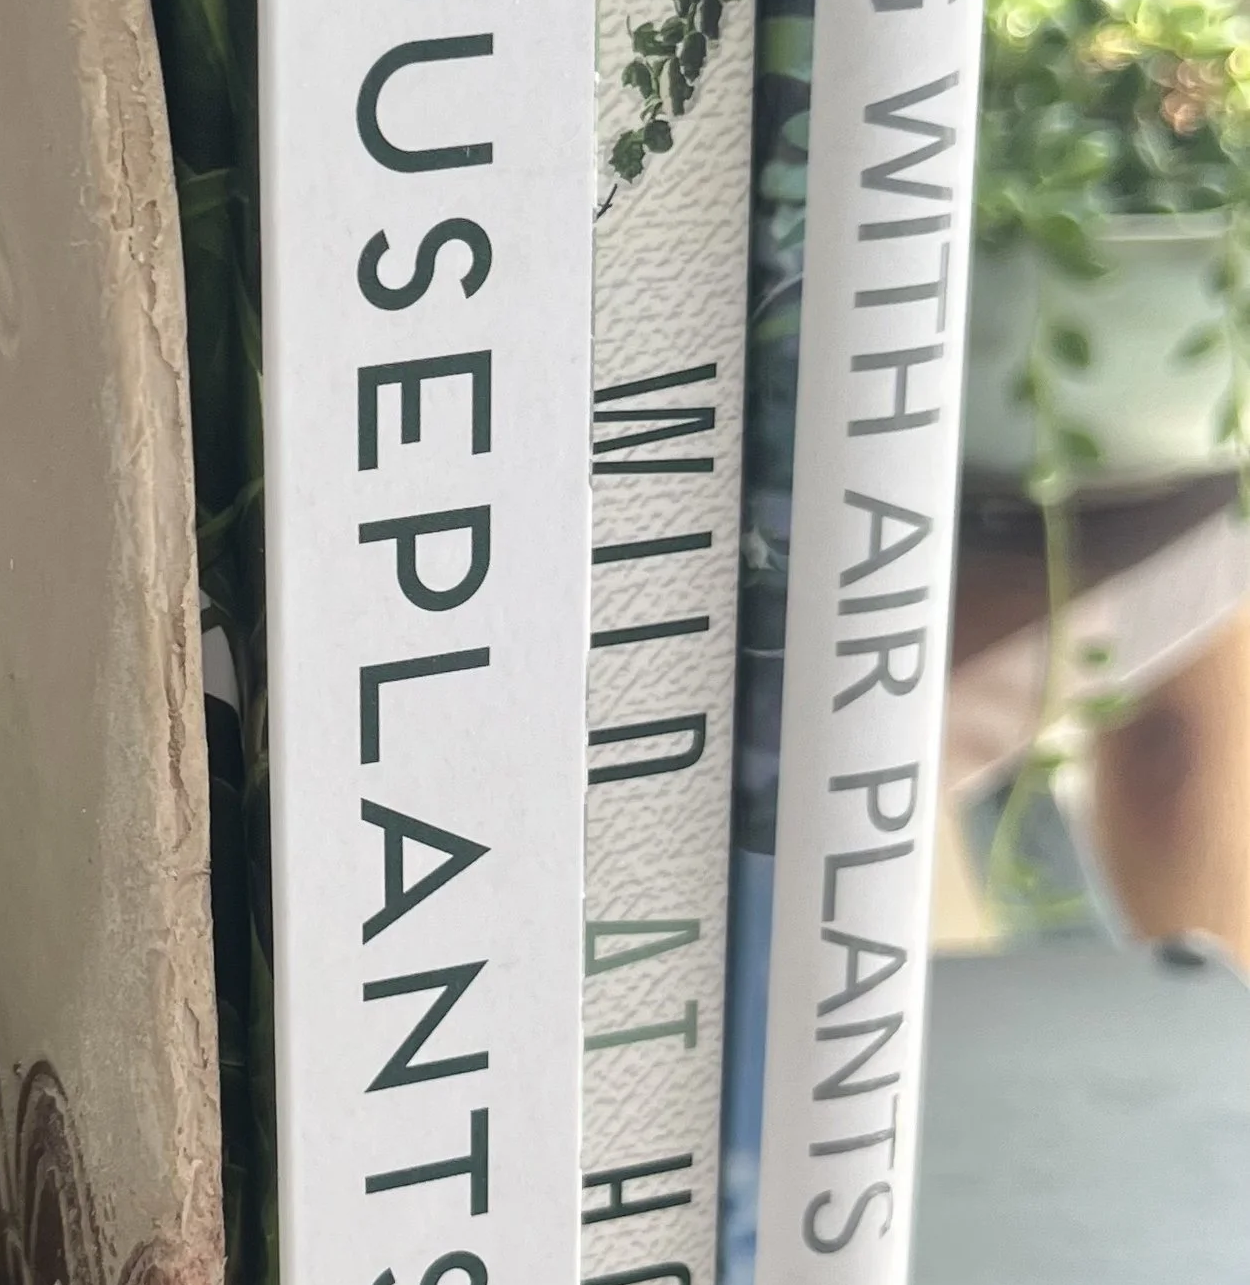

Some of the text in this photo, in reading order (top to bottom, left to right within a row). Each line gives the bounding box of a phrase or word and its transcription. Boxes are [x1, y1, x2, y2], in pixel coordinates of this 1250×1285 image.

[847, 69, 960, 438] WITH
[832, 488, 934, 713] AIR
[583, 918, 700, 1053] AT
[803, 760, 921, 1255] PLANTS
